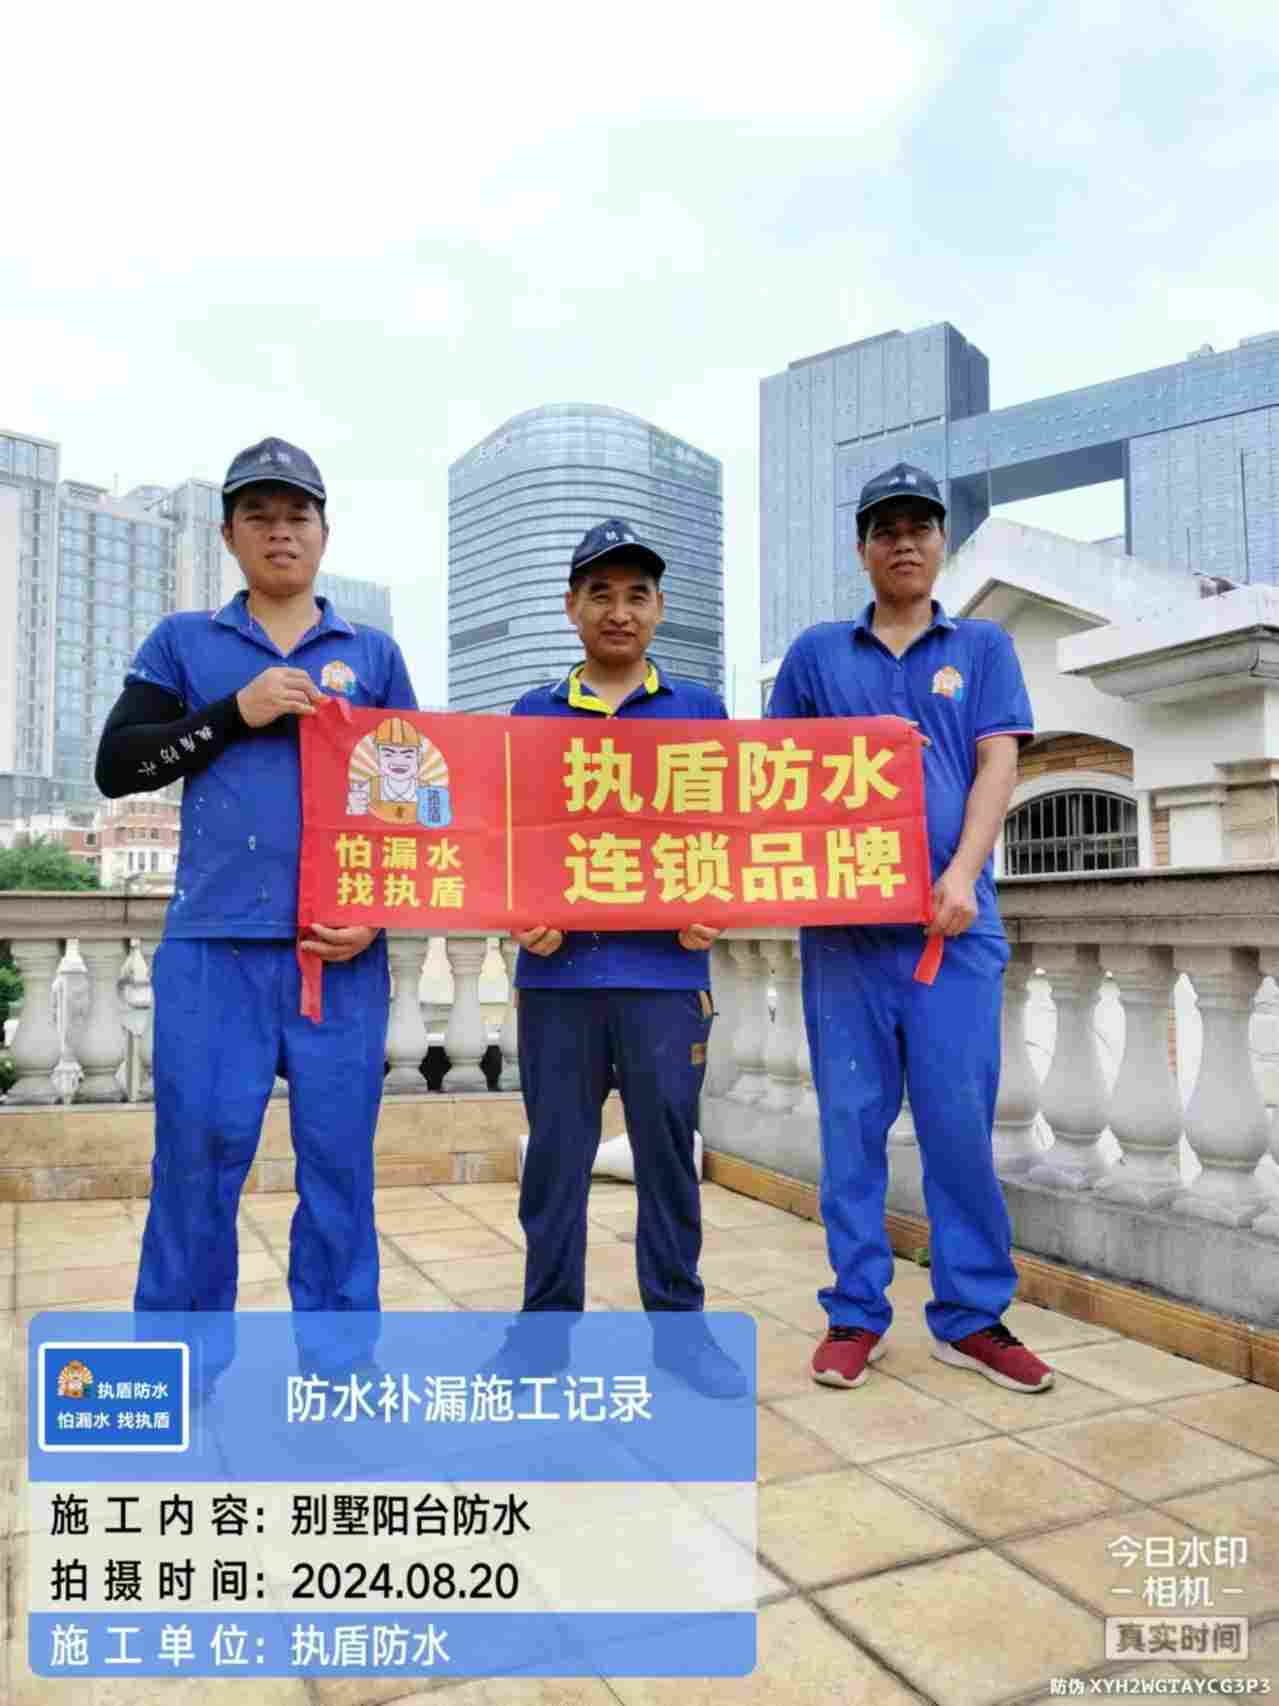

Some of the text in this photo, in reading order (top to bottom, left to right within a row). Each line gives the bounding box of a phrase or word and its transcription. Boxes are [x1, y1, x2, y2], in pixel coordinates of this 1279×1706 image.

[563, 735, 901, 814] 执盾防水
[335, 832, 463, 871] 怕漏水
[563, 826, 907, 905] 连锁品牌
[337, 872, 466, 909] 找执盾
